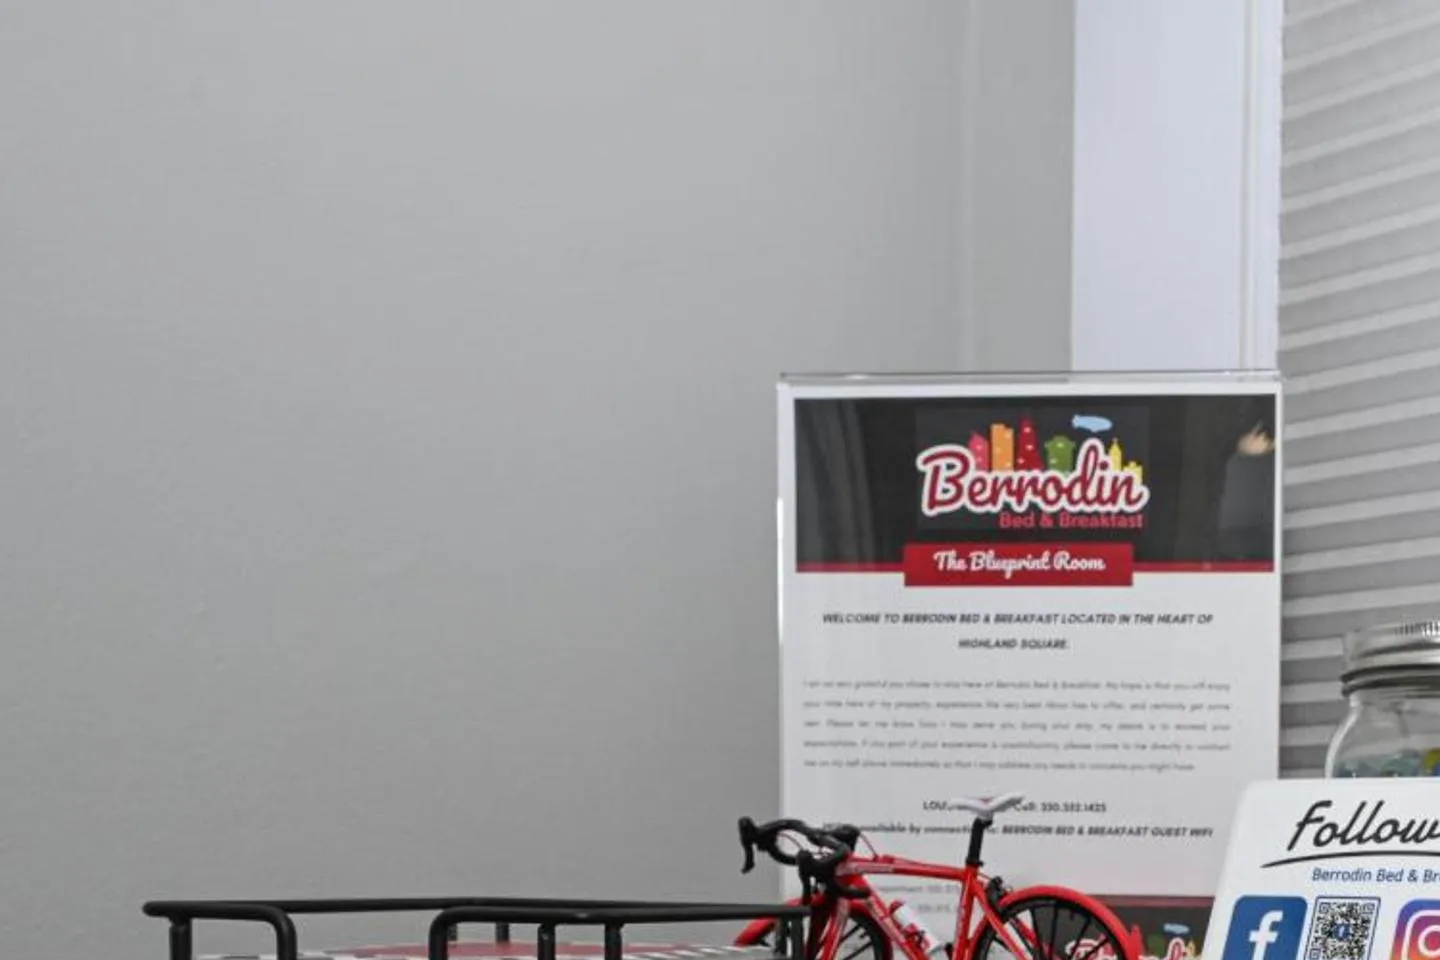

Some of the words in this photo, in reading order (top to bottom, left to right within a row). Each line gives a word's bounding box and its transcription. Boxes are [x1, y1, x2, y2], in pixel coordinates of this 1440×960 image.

[918, 440, 1148, 514] Berrodin
[1000, 512, 1034, 527] Bed
[1039, 514, 1053, 527] &
[1060, 512, 1143, 528] Breakfast
[934, 550, 967, 571] The
[970, 550, 1050, 579] Blueprint
[1053, 551, 1106, 571] Room
[823, 613, 881, 624] WELCOME
[884, 613, 899, 624] TO
[959, 613, 980, 624] BED
[994, 613, 1059, 624] BREAKFAST
[1061, 613, 1116, 624] LOCATED
[1118, 613, 1131, 624] IN
[1134, 613, 1154, 624] THE
[1157, 613, 1195, 624] HEART
[1197, 613, 1214, 624] OF
[1088, 826, 1148, 837] BREAKFAST
[1151, 826, 1187, 837] GUEST
[1312, 867, 1372, 883] Berrodin
[1376, 868, 1405, 883] Bed
[1408, 869, 1418, 883] &
